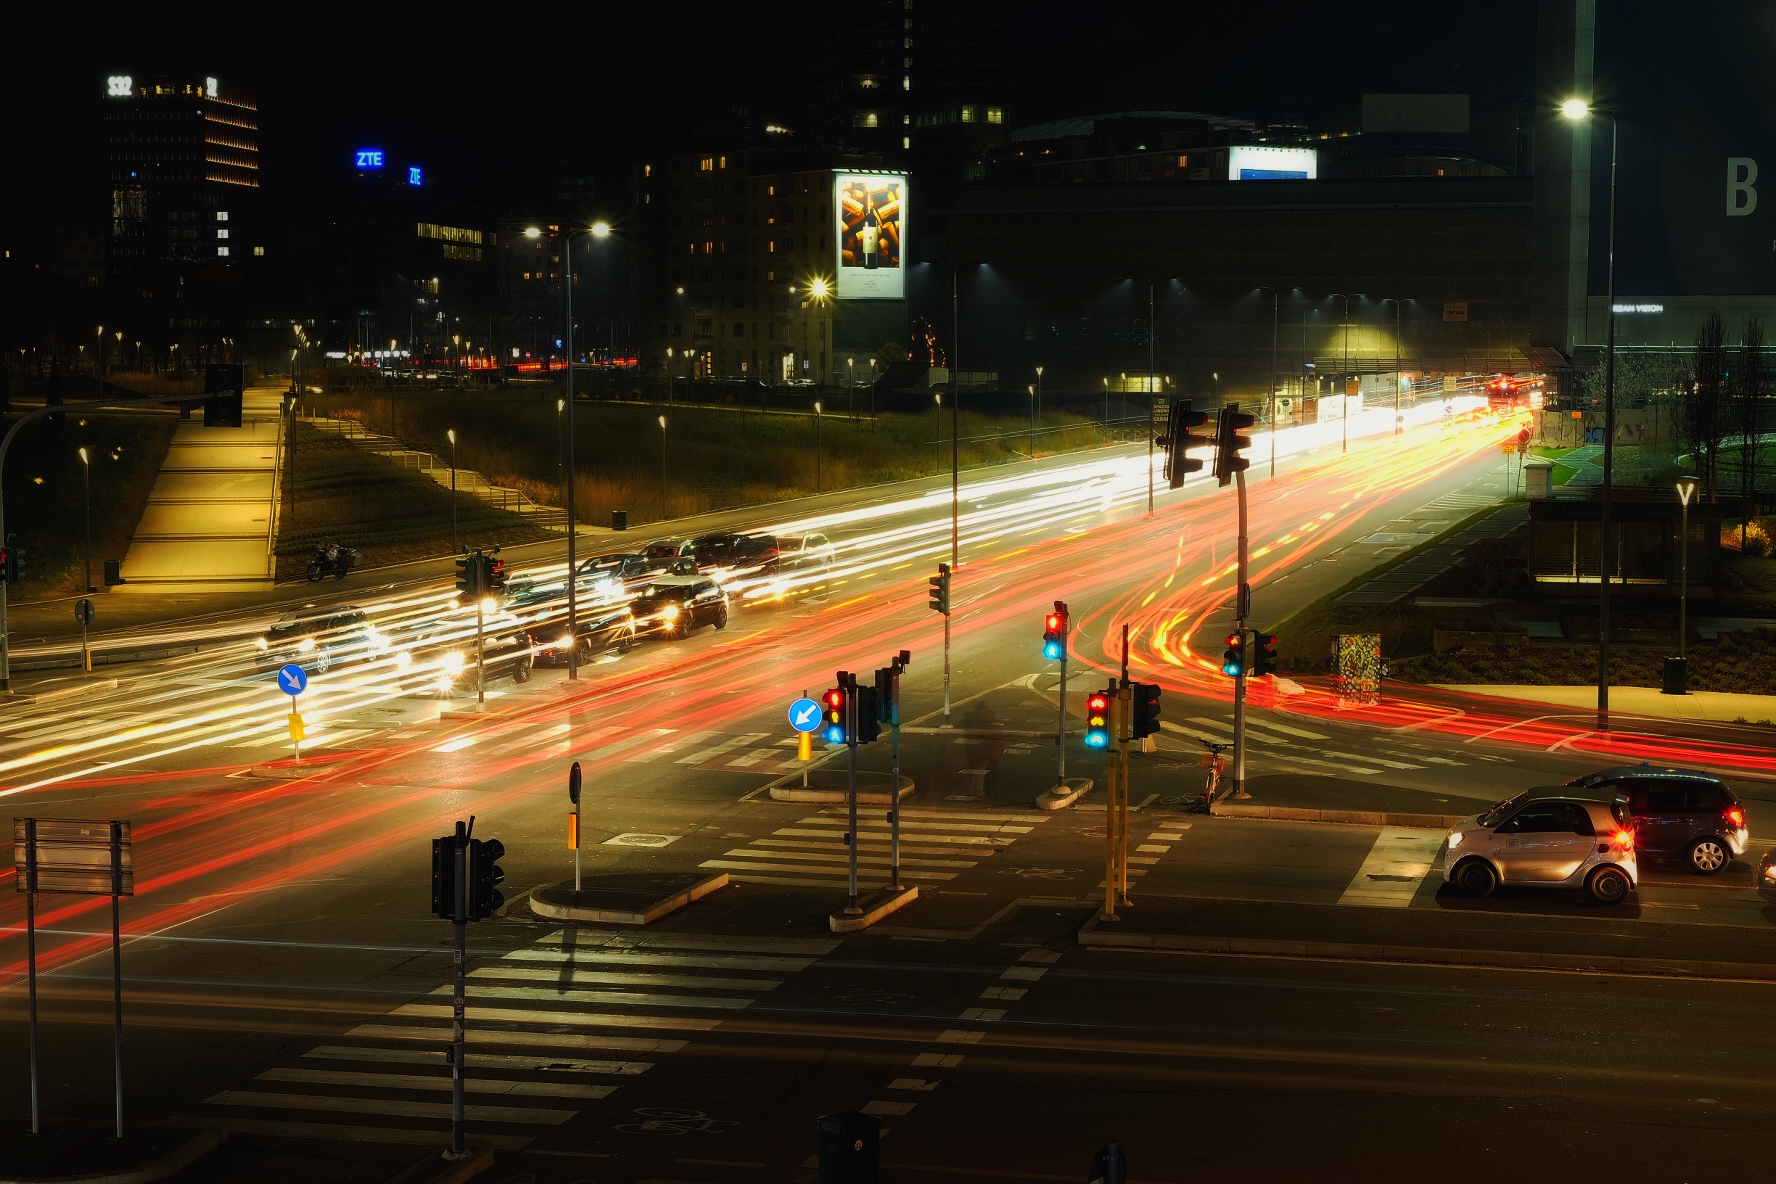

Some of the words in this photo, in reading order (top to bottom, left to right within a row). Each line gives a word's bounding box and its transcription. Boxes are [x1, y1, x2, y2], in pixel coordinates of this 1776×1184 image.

[357, 152, 382, 166] ZTE
[409, 167, 421, 185] ZTE
[1726, 157, 1759, 216] B
